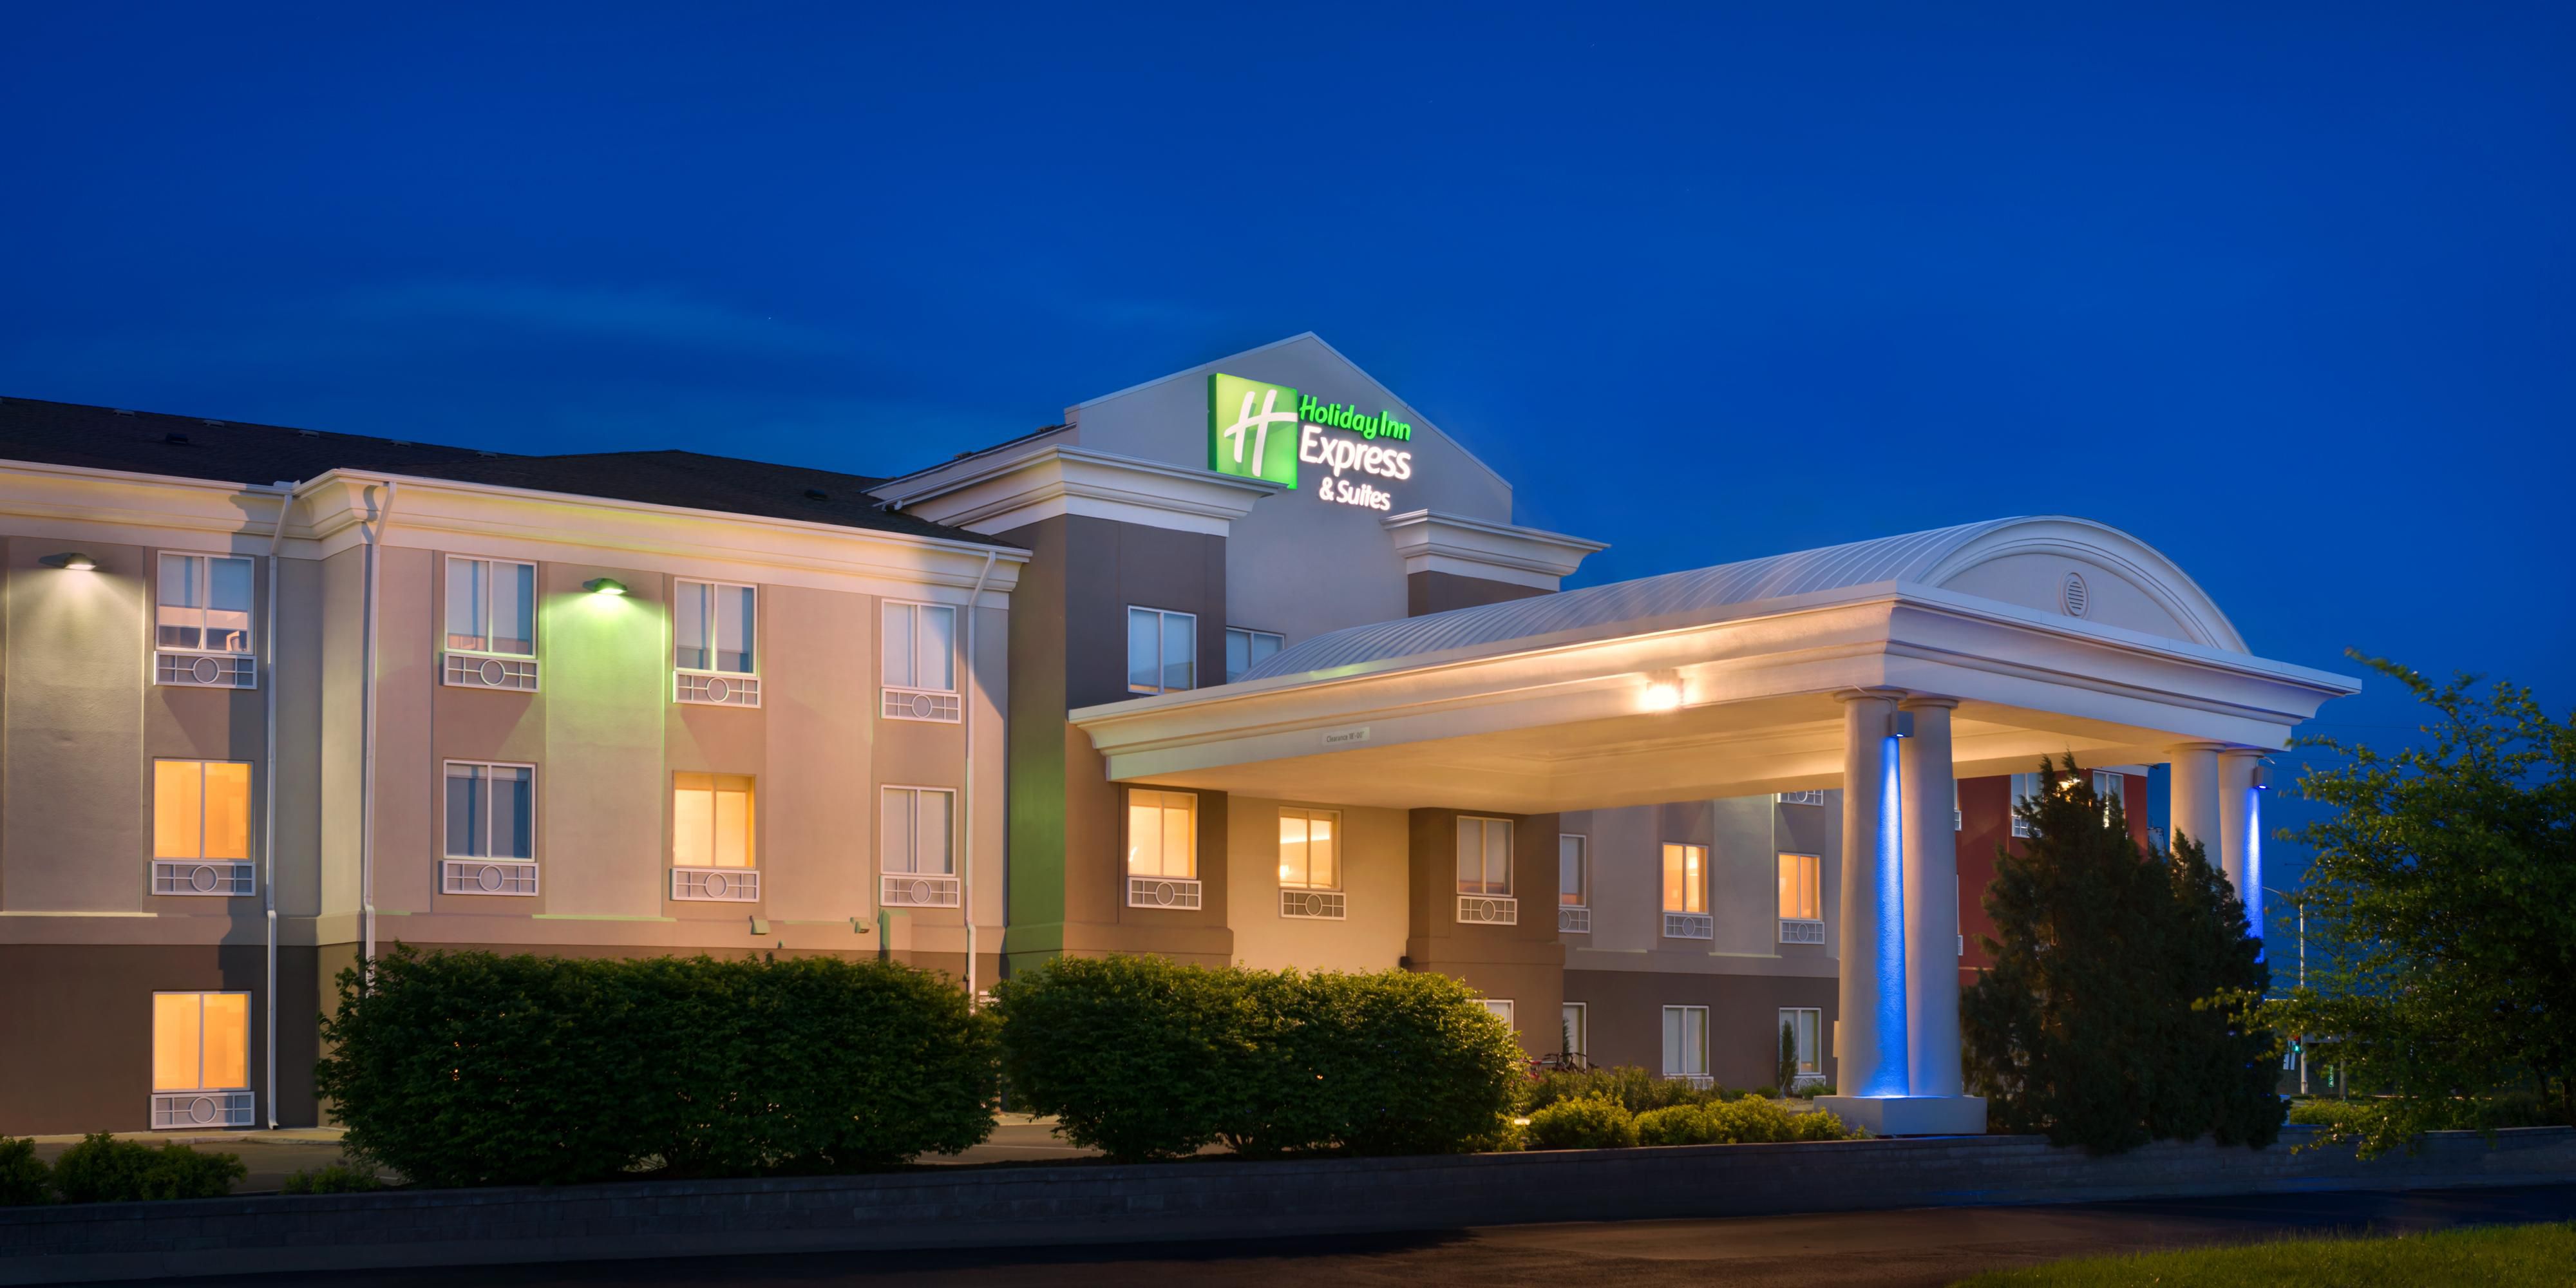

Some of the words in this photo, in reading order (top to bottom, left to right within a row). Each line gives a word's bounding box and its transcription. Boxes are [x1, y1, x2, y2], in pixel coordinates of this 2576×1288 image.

[1299, 394, 1378, 439] Holiday
[1379, 410, 1411, 441] Inn
[1300, 425, 1411, 480] Express
[1319, 477, 1334, 500] &
[1336, 480, 1391, 511] Suites
